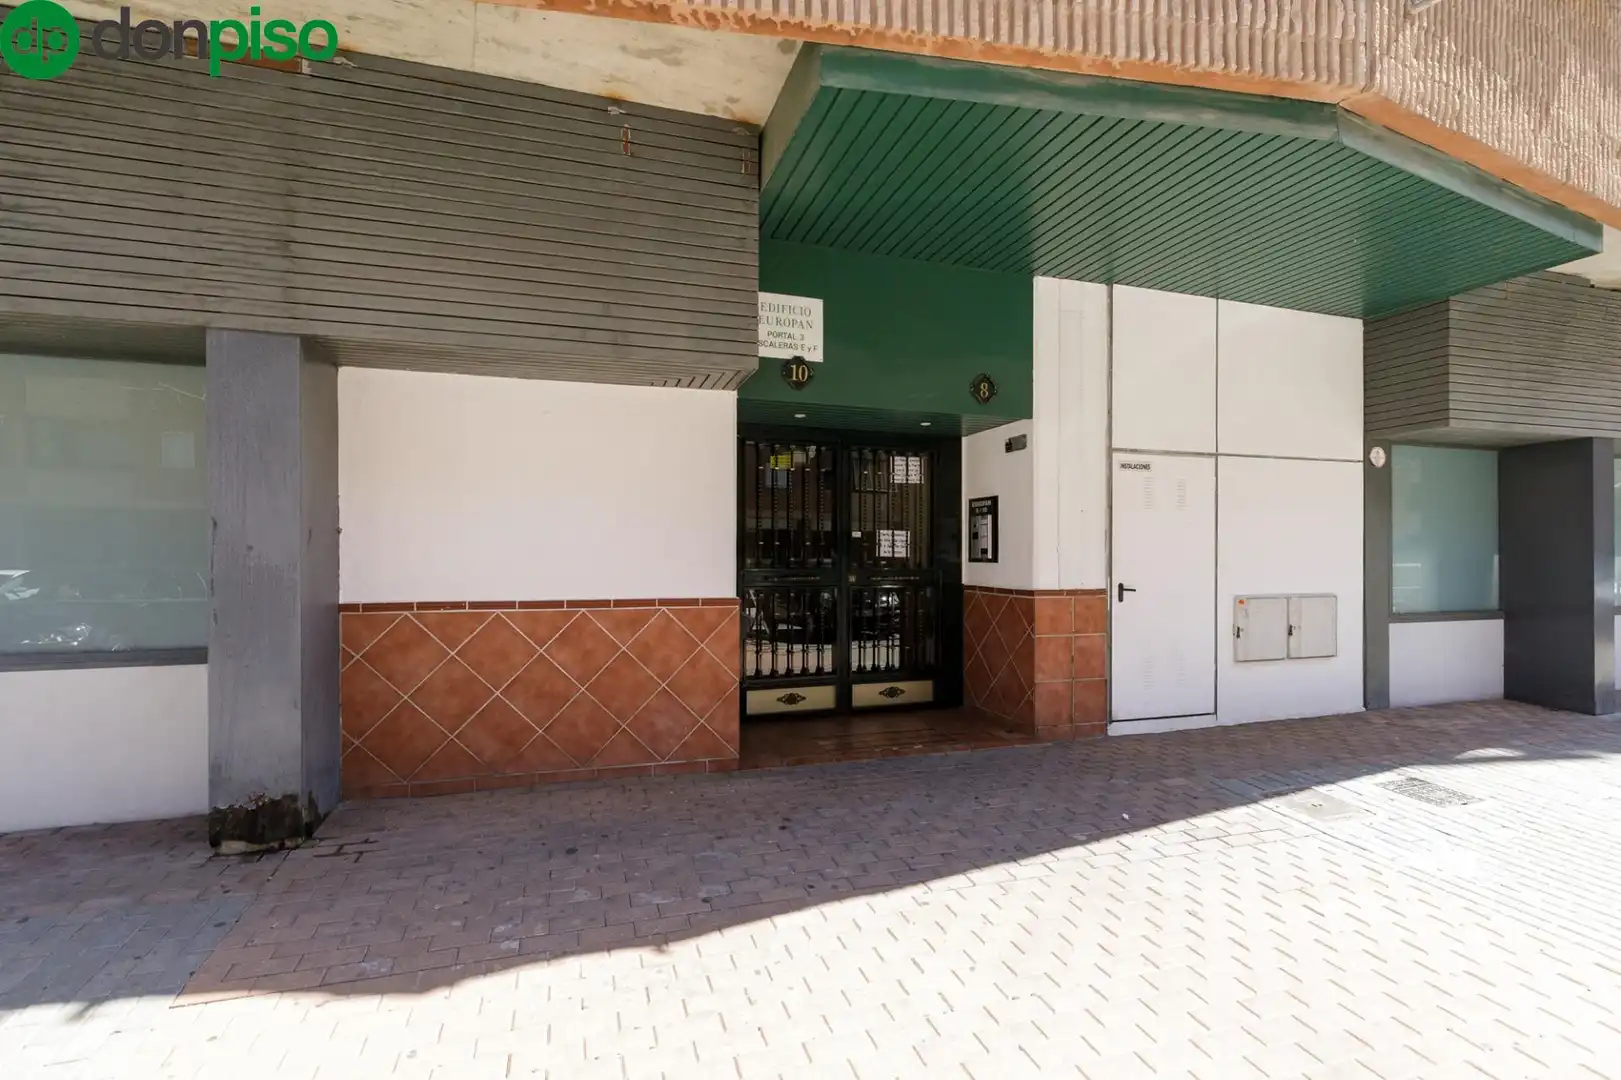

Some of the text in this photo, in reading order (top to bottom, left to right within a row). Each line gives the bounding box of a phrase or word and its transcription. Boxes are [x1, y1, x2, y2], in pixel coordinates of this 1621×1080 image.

[760, 302, 812, 317] EDIFICIO
[758, 315, 814, 329] EUROPAN
[767, 330, 805, 341] PORTAL 3
[757, 340, 799, 351] SCALERAS
[790, 364, 808, 382] 10
[980, 382, 989, 398] 8
